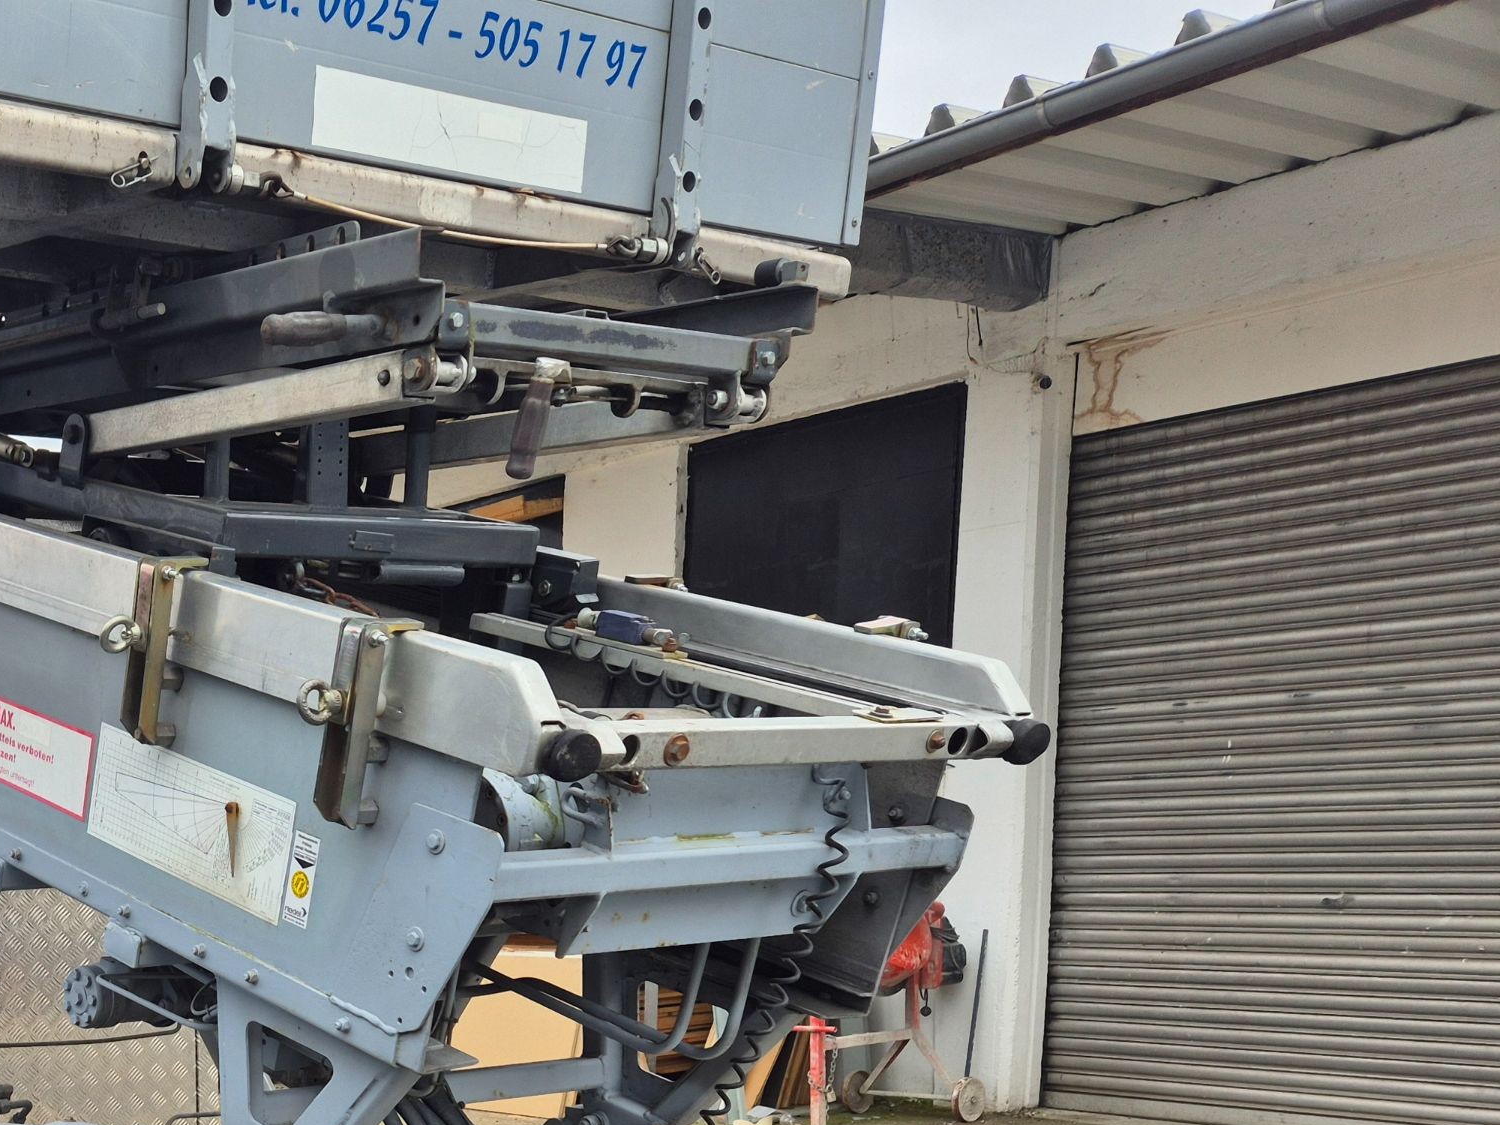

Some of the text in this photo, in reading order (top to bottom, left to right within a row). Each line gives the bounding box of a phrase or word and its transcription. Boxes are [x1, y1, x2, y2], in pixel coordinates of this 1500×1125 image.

[475, 11, 544, 68] 505
[557, 29, 598, 79] 17
[605, 39, 648, 89] 97
[18, 742, 54, 764] verboten!
